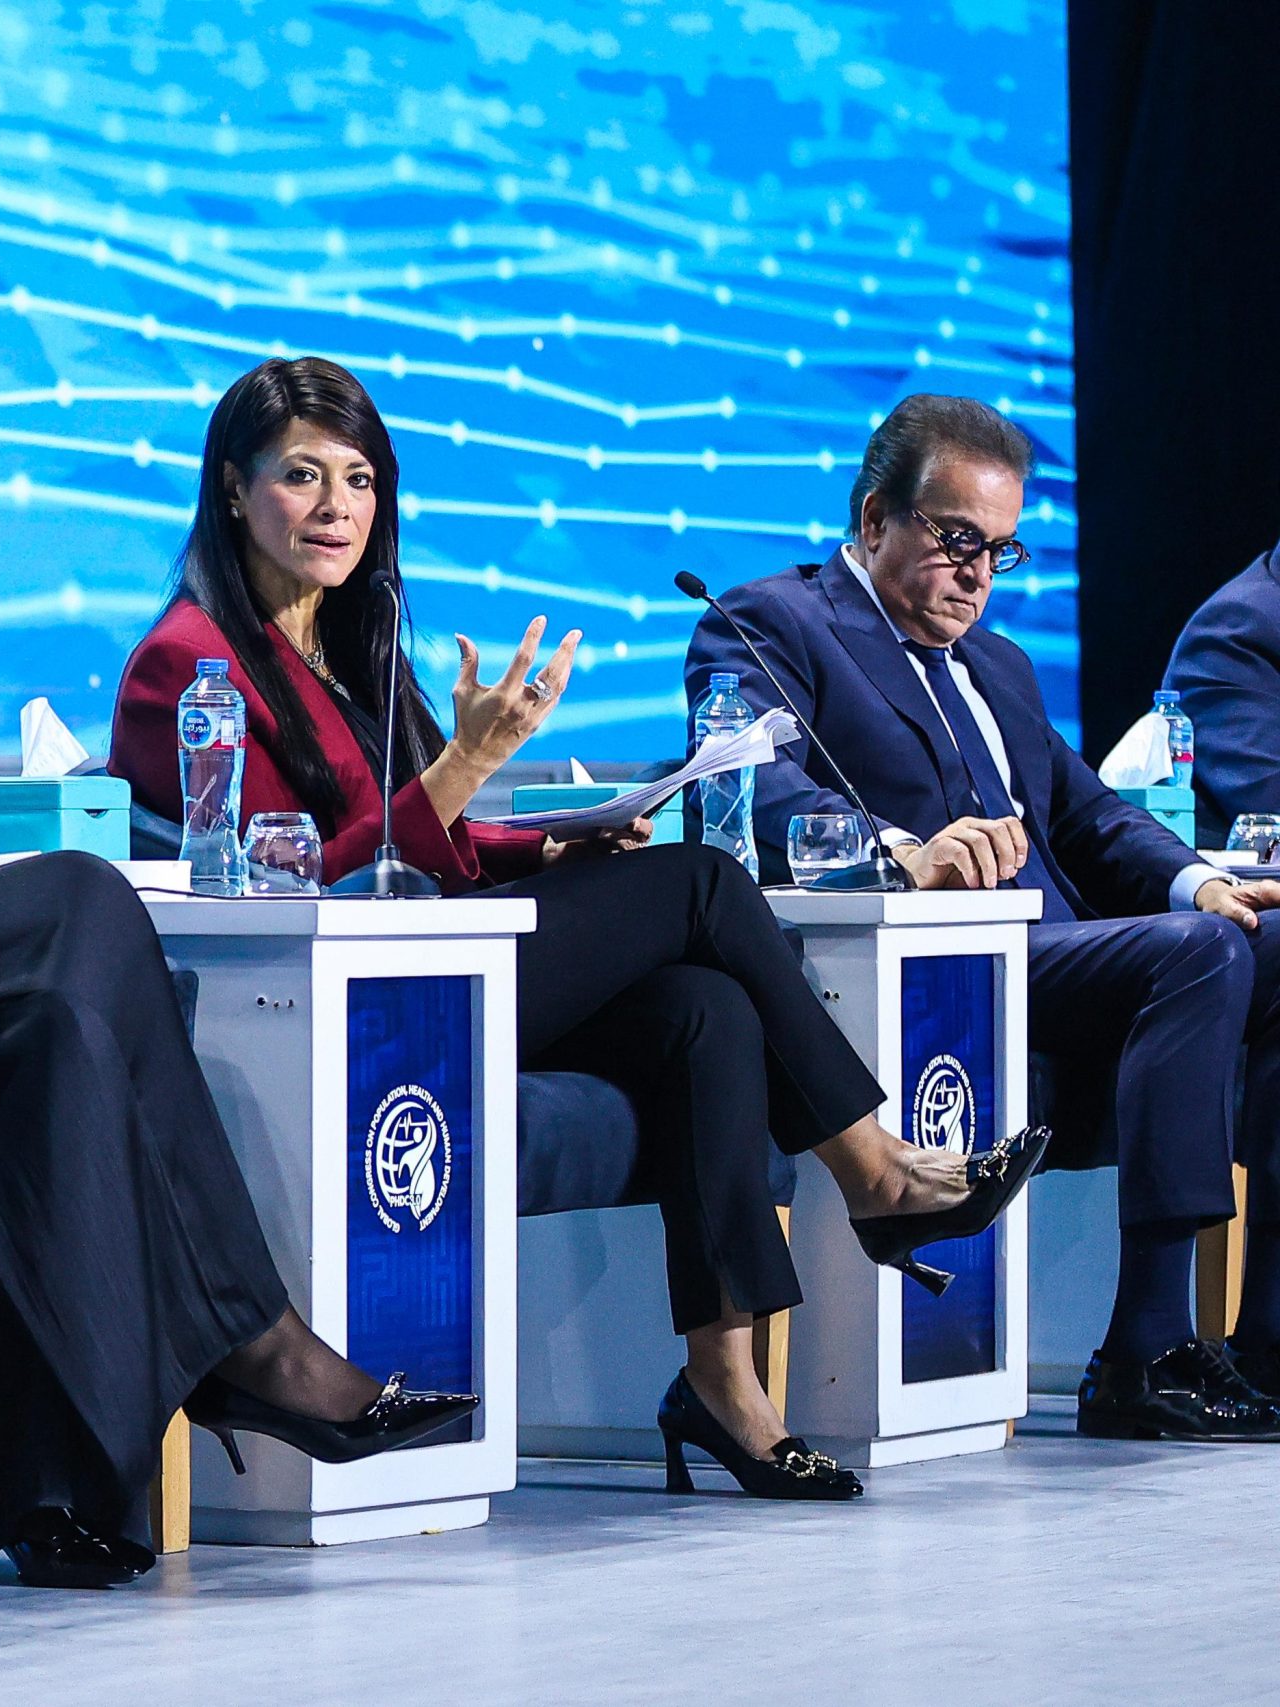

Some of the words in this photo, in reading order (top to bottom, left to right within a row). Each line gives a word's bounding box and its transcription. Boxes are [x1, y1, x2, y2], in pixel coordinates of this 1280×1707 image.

[408, 1085, 433, 1104] HEALTH
[431, 1101, 444, 1122] AND
[366, 1130, 375, 1148] ON
[440, 1122, 452, 1163] HUMAN
[364, 1149, 379, 1208] CONGRESS
[419, 1165, 451, 1232] DEVELOPMENT
[377, 1205, 400, 1234] GLOBAL
